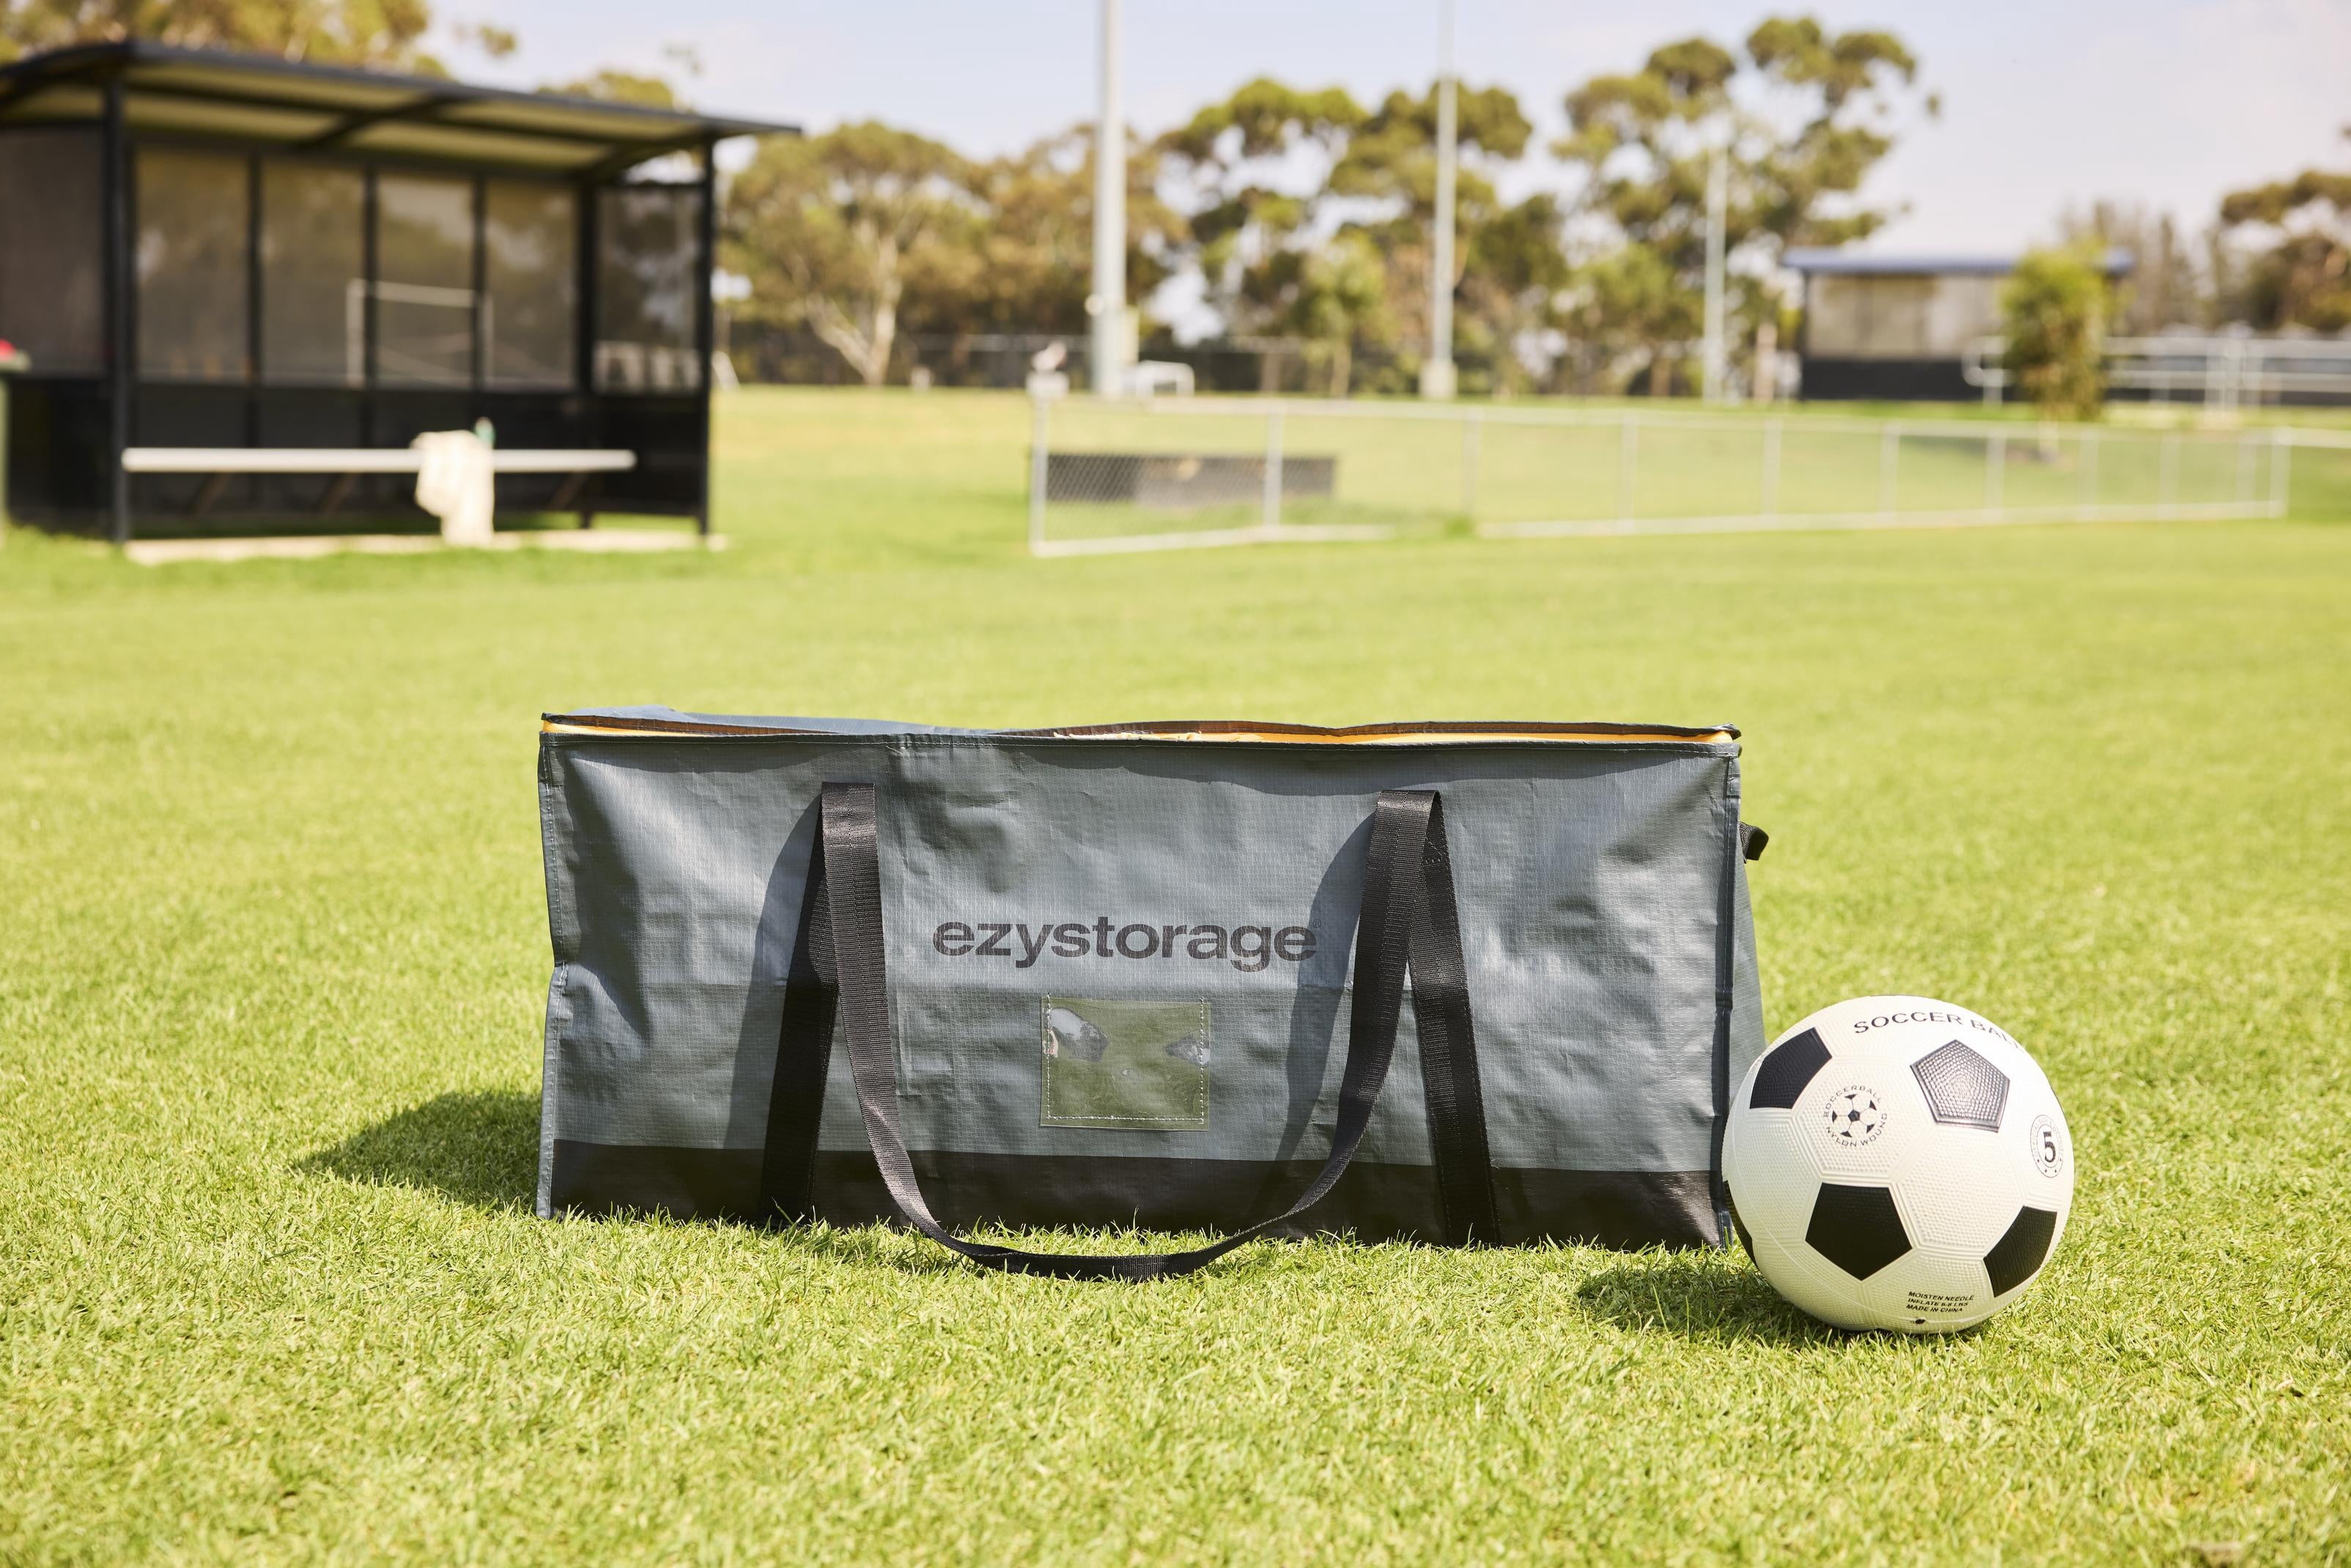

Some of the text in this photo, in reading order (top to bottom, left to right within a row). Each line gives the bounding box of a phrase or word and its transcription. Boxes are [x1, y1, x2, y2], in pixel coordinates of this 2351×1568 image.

[933, 917, 1316, 972] ezystorage
[1853, 1012, 1963, 1033] SOCCER
[1826, 1114, 1887, 1147] NYLON WOUND
[2043, 1131, 2056, 1163] 5
[1908, 1291, 1944, 1301] MOISTEN
[1908, 1298, 1940, 1306] INFLATE
[1906, 1303, 1929, 1312] MADE
